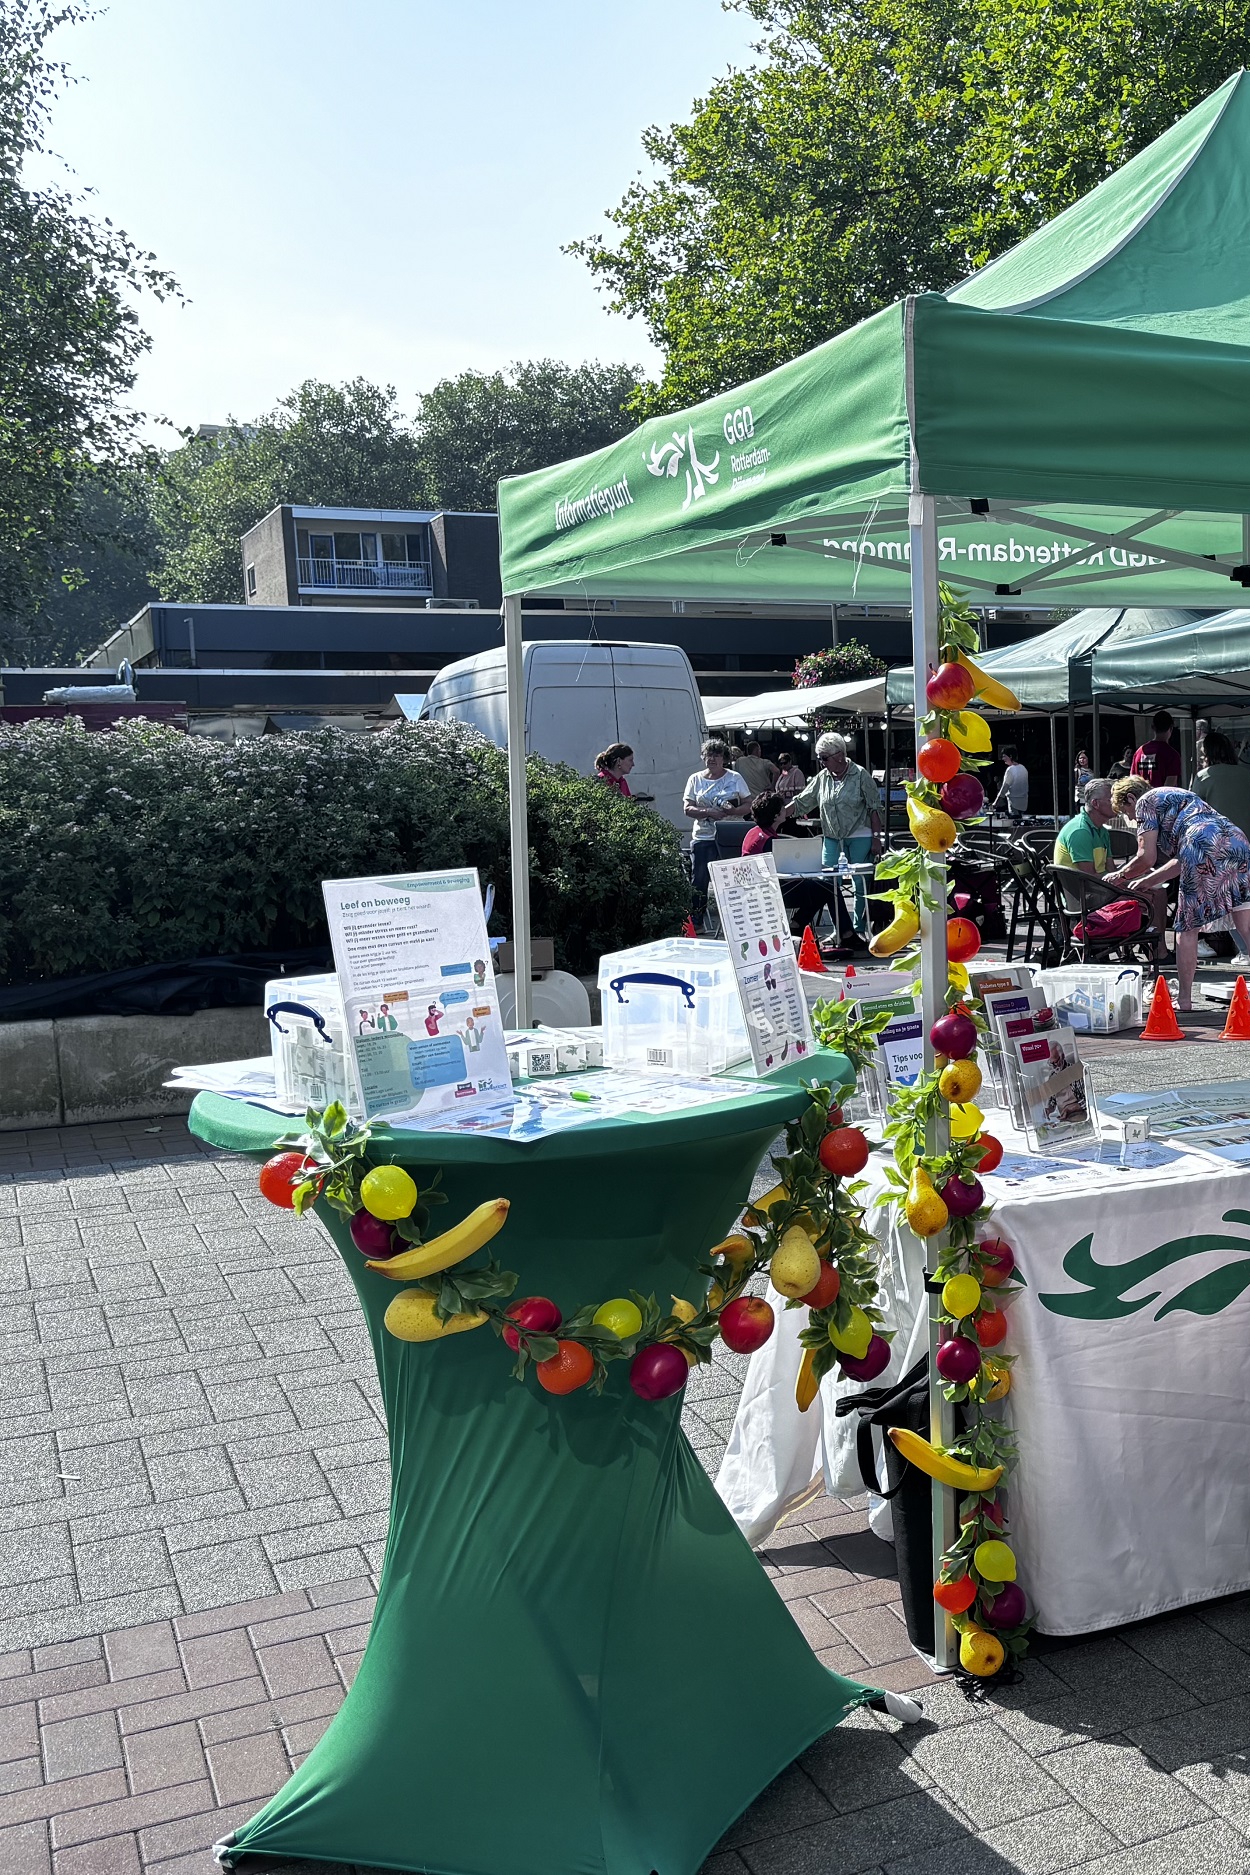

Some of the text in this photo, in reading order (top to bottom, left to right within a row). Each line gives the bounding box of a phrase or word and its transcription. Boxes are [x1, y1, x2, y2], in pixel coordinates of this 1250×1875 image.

[724, 406, 754, 445] GGD
[730, 447, 772, 473] Rotterdam-
[555, 472, 634, 531] Informatiepunt
[340, 901, 358, 909] Leef
[374, 896, 410, 907] beweeg
[892, 1052, 923, 1064] Tips voo
